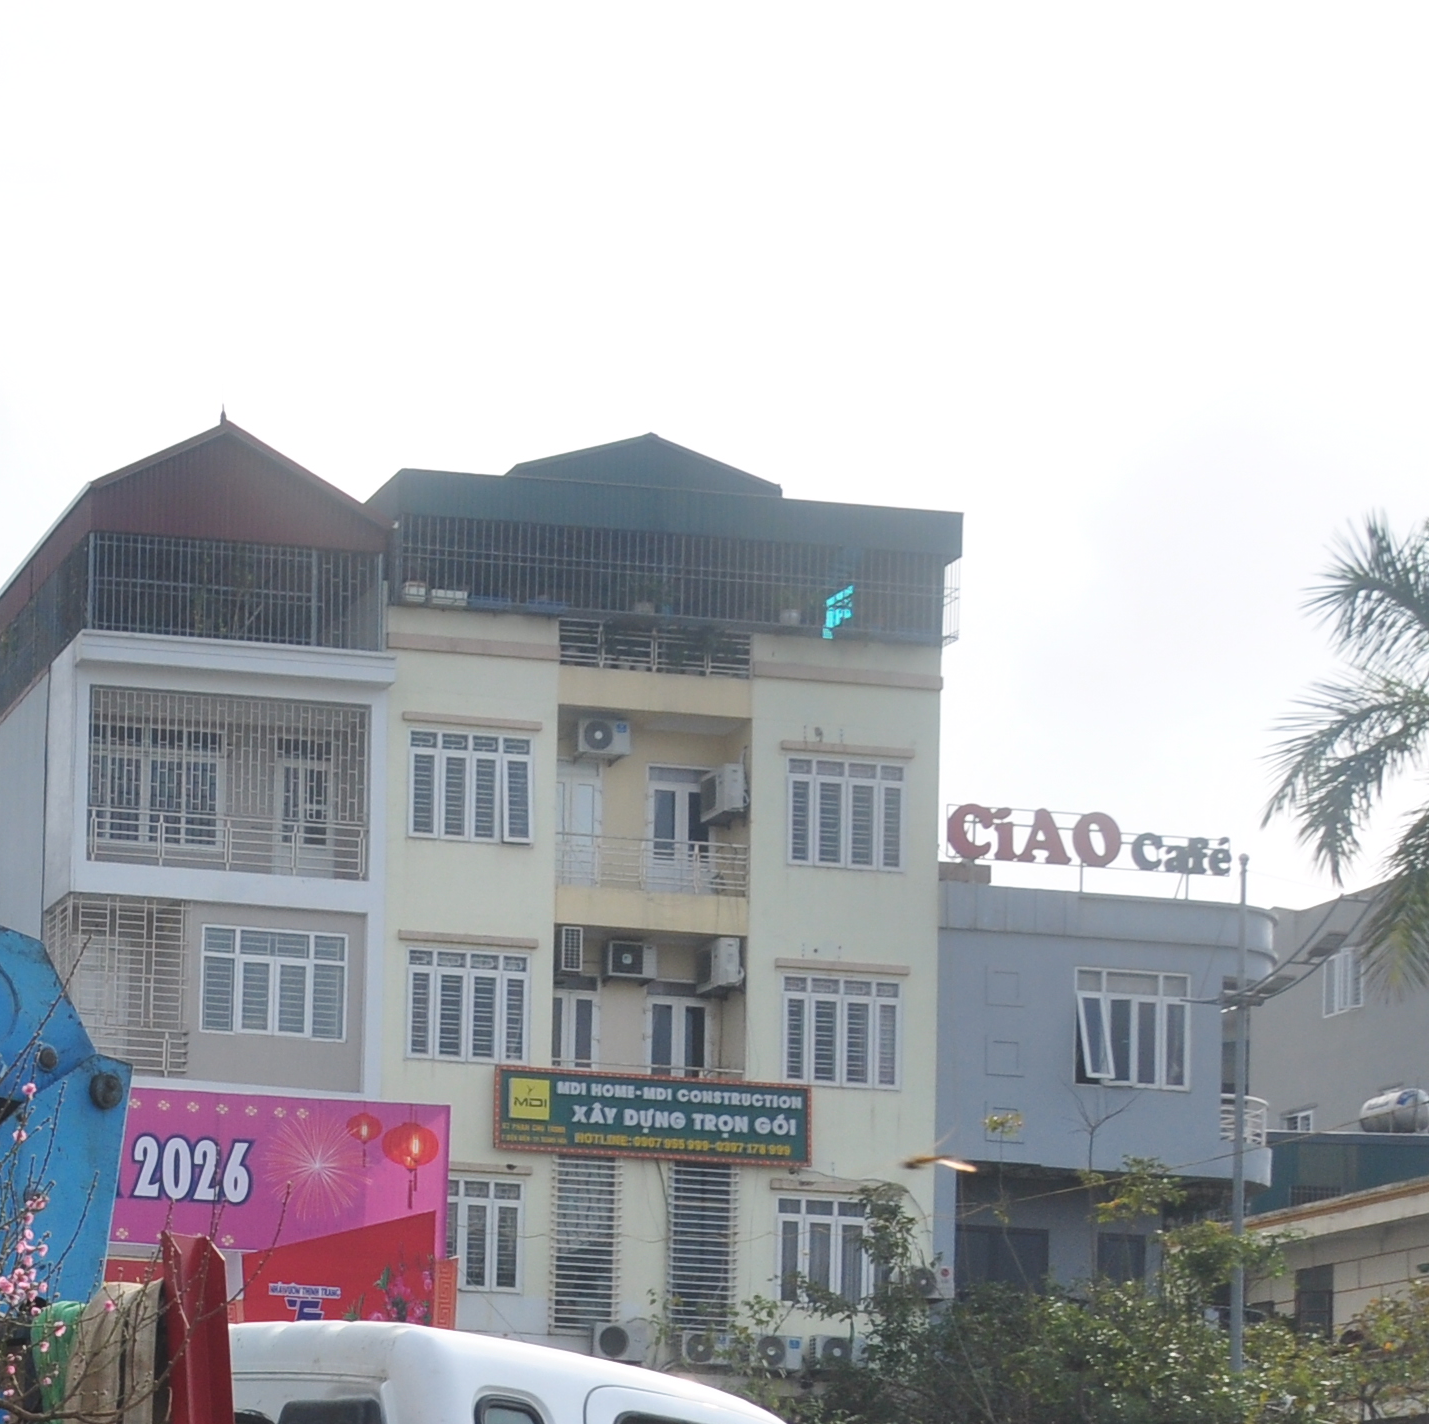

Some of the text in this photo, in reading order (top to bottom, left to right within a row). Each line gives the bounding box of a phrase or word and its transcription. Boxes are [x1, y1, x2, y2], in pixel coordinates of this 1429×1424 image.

[1131, 832, 1232, 876] Café
[513, 1097, 548, 1109] MDI
[556, 1080, 587, 1096] MDI
[677, 1088, 803, 1110] CONSTRUCTION
[572, 1102, 797, 1138] XÂY DỰNG TRỌN GÓI
[574, 1132, 632, 1147] HOTLINE:
[132, 1135, 251, 1205] 2026
